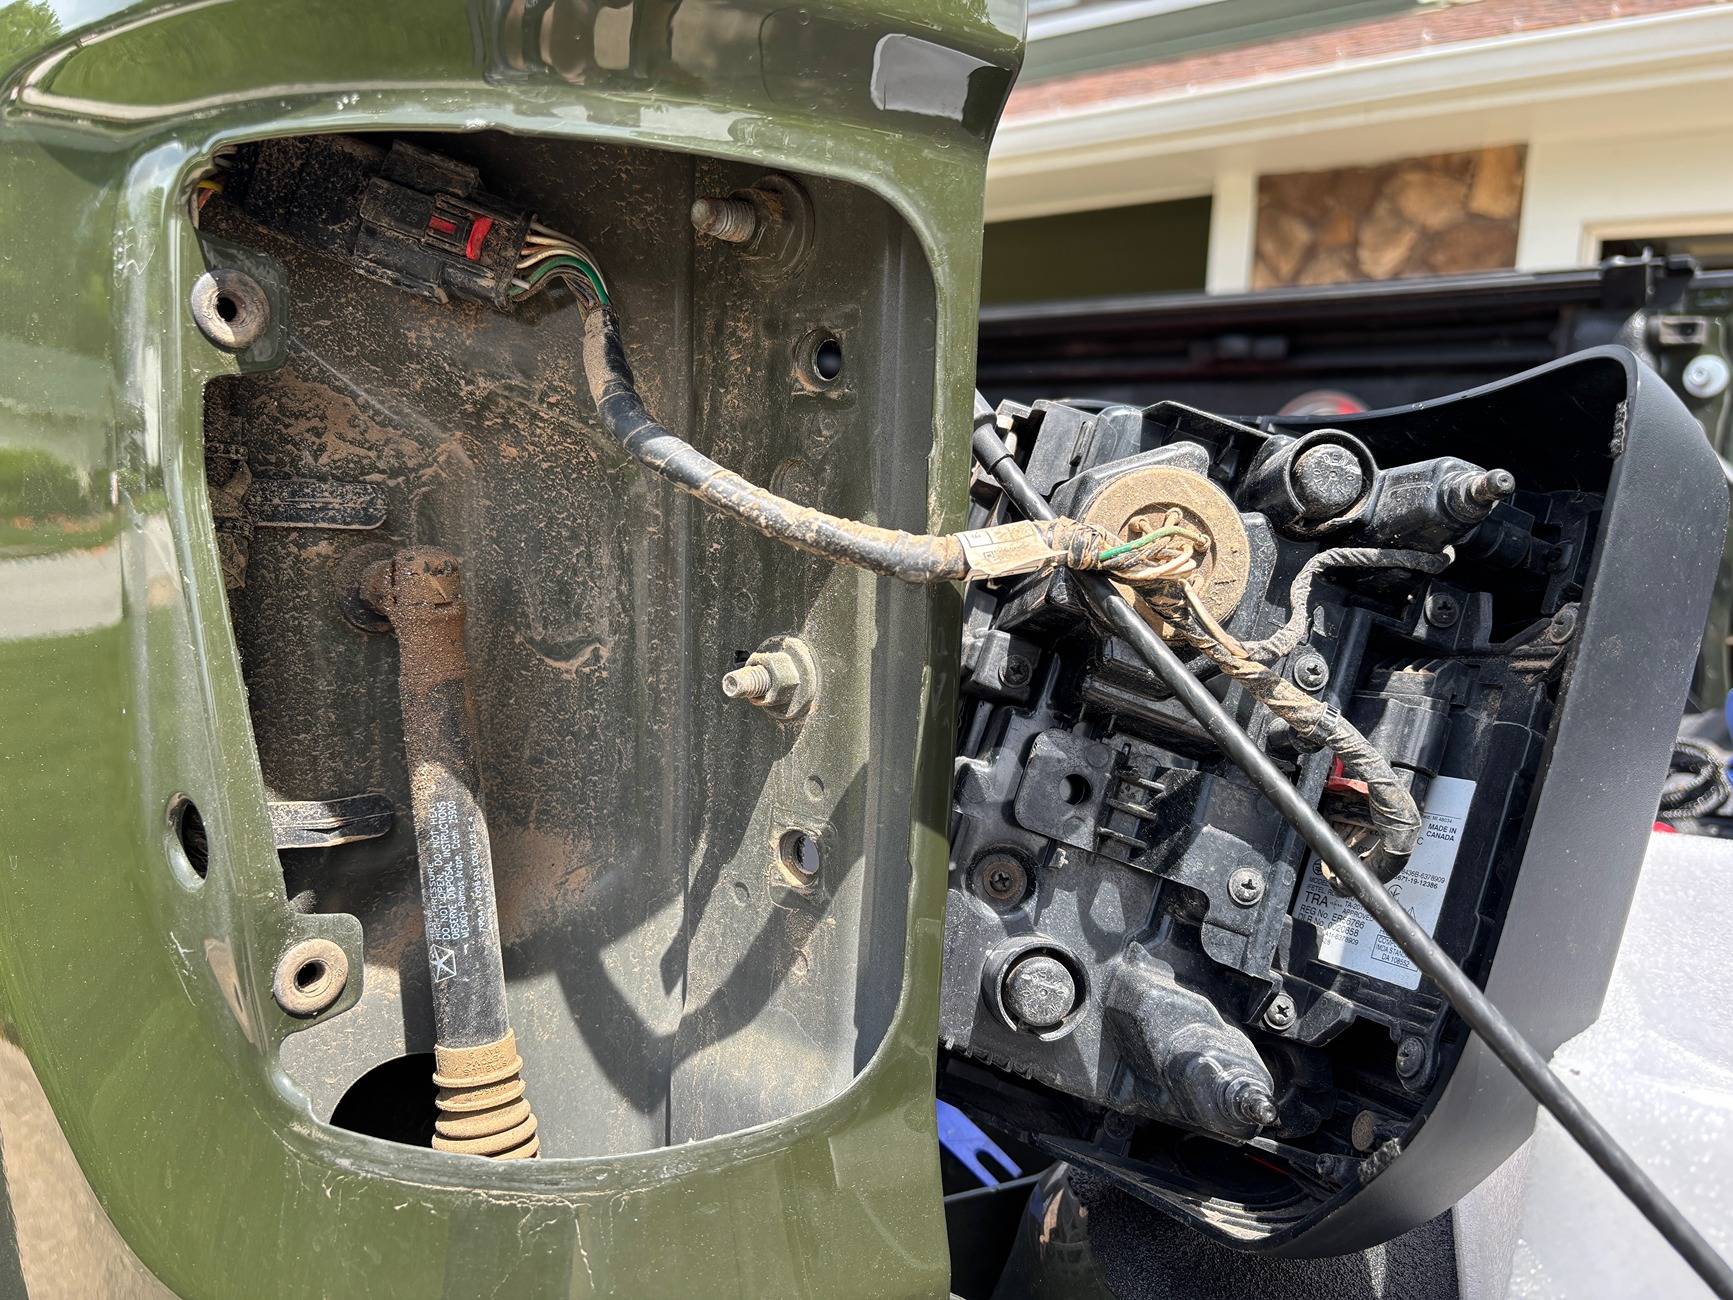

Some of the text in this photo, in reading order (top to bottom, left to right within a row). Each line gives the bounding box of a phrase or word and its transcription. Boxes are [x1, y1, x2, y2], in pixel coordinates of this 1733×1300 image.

[1427, 823, 1448, 833] MADE
[430, 830, 440, 847] NOT
[1426, 831, 1455, 842] CANADA
[434, 854, 442, 866] DO
[437, 801, 461, 940] OBSERVE DISPOSAL INSTRUCTIONS
[427, 862, 438, 911] PRESSURE
[1305, 891, 1328, 907] TRA
[440, 904, 449, 921] NOT
[1299, 904, 1316, 916] REG
[1315, 908, 1329, 919] No.
[442, 928, 450, 940] DO
